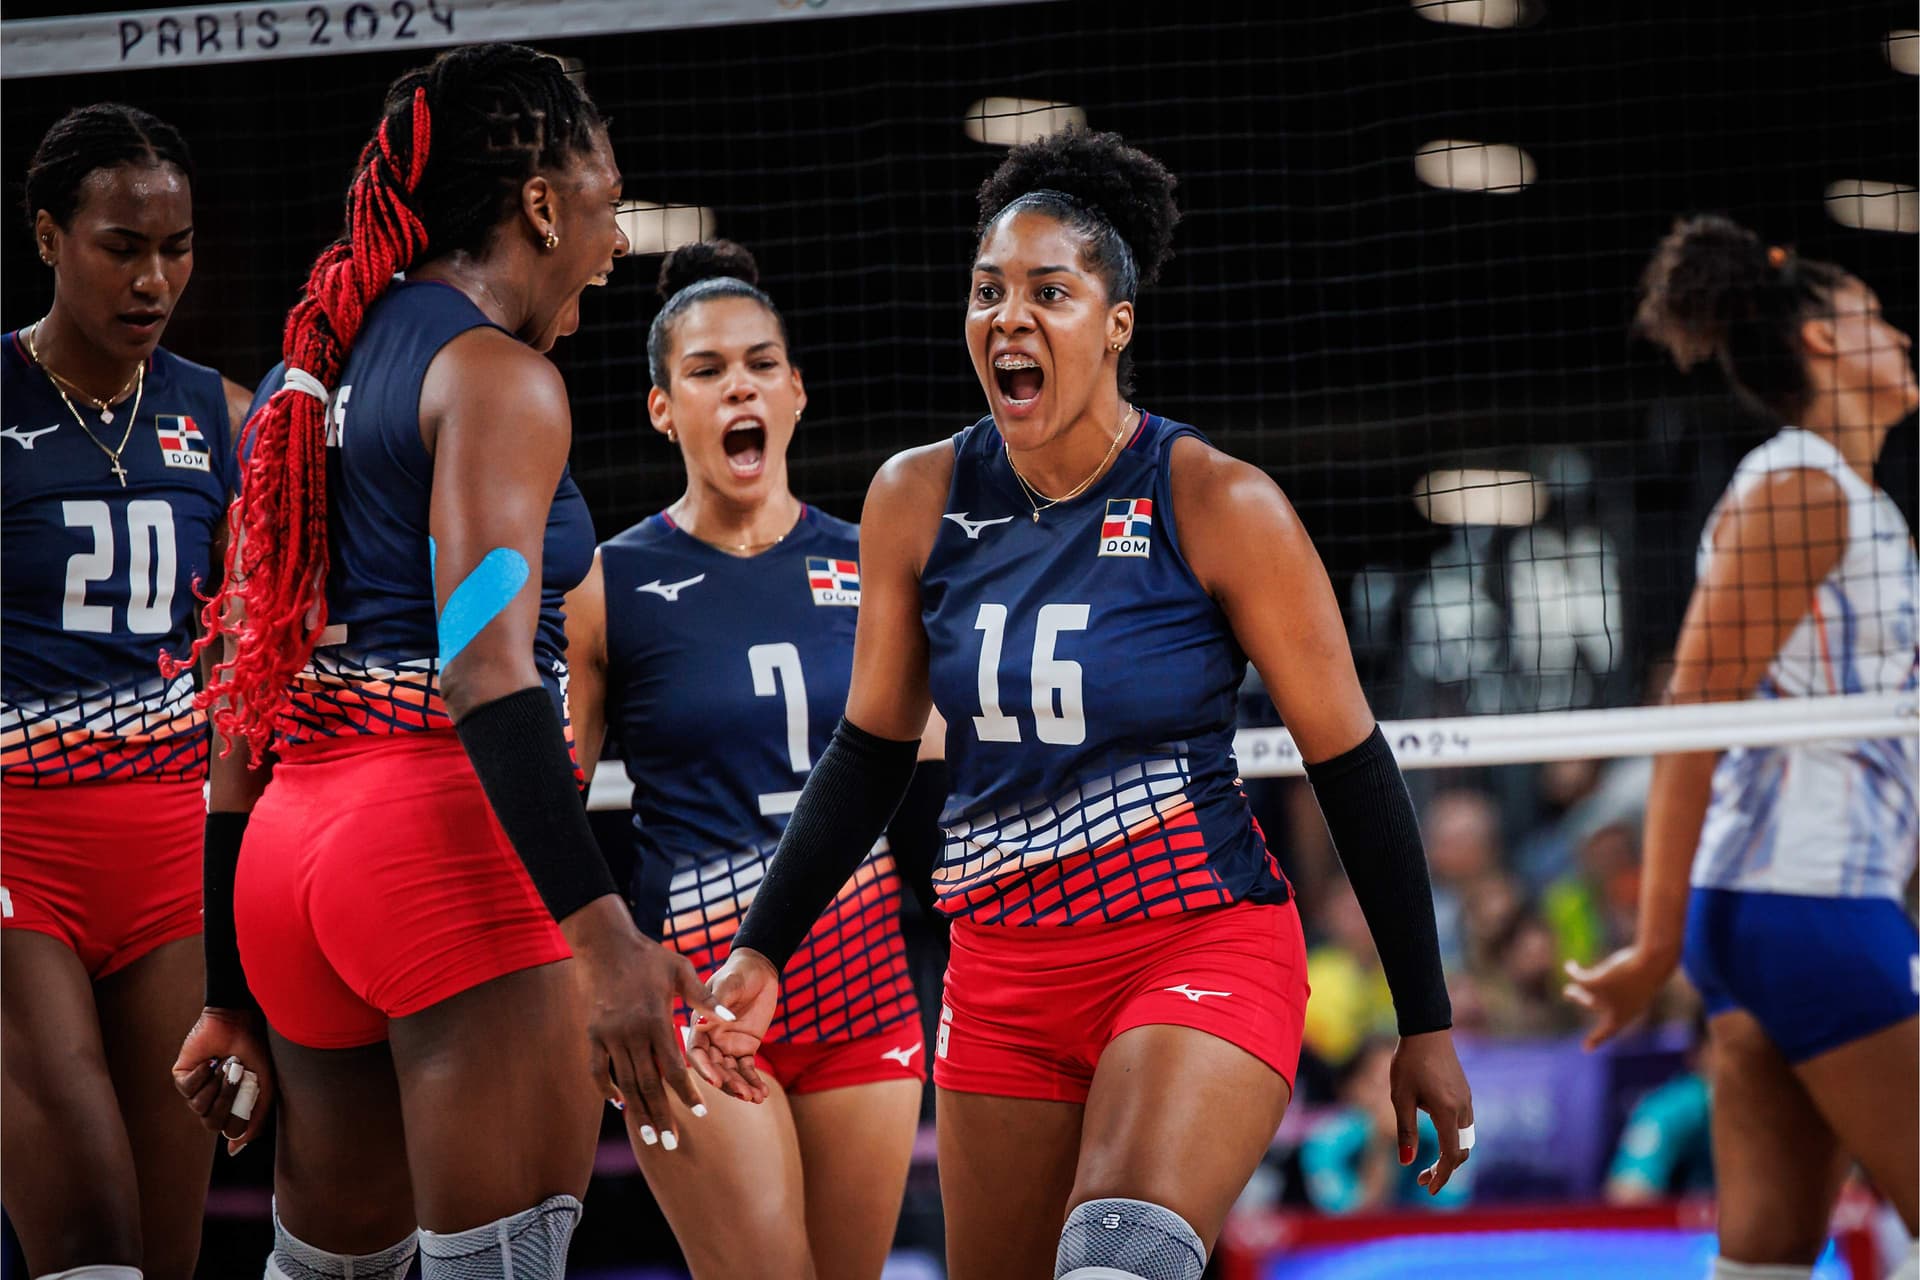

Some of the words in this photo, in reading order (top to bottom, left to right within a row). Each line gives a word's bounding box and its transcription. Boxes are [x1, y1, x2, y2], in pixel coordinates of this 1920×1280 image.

[118, 10, 281, 60] PARIS
[305, 0, 456, 46] 2024
[172, 453, 205, 466] DOM
[62, 500, 177, 635] 20
[1106, 540, 1147, 553] DOM
[972, 603, 1091, 746] 16
[748, 642, 812, 773] 7
[936, 1003, 954, 1059] 6
